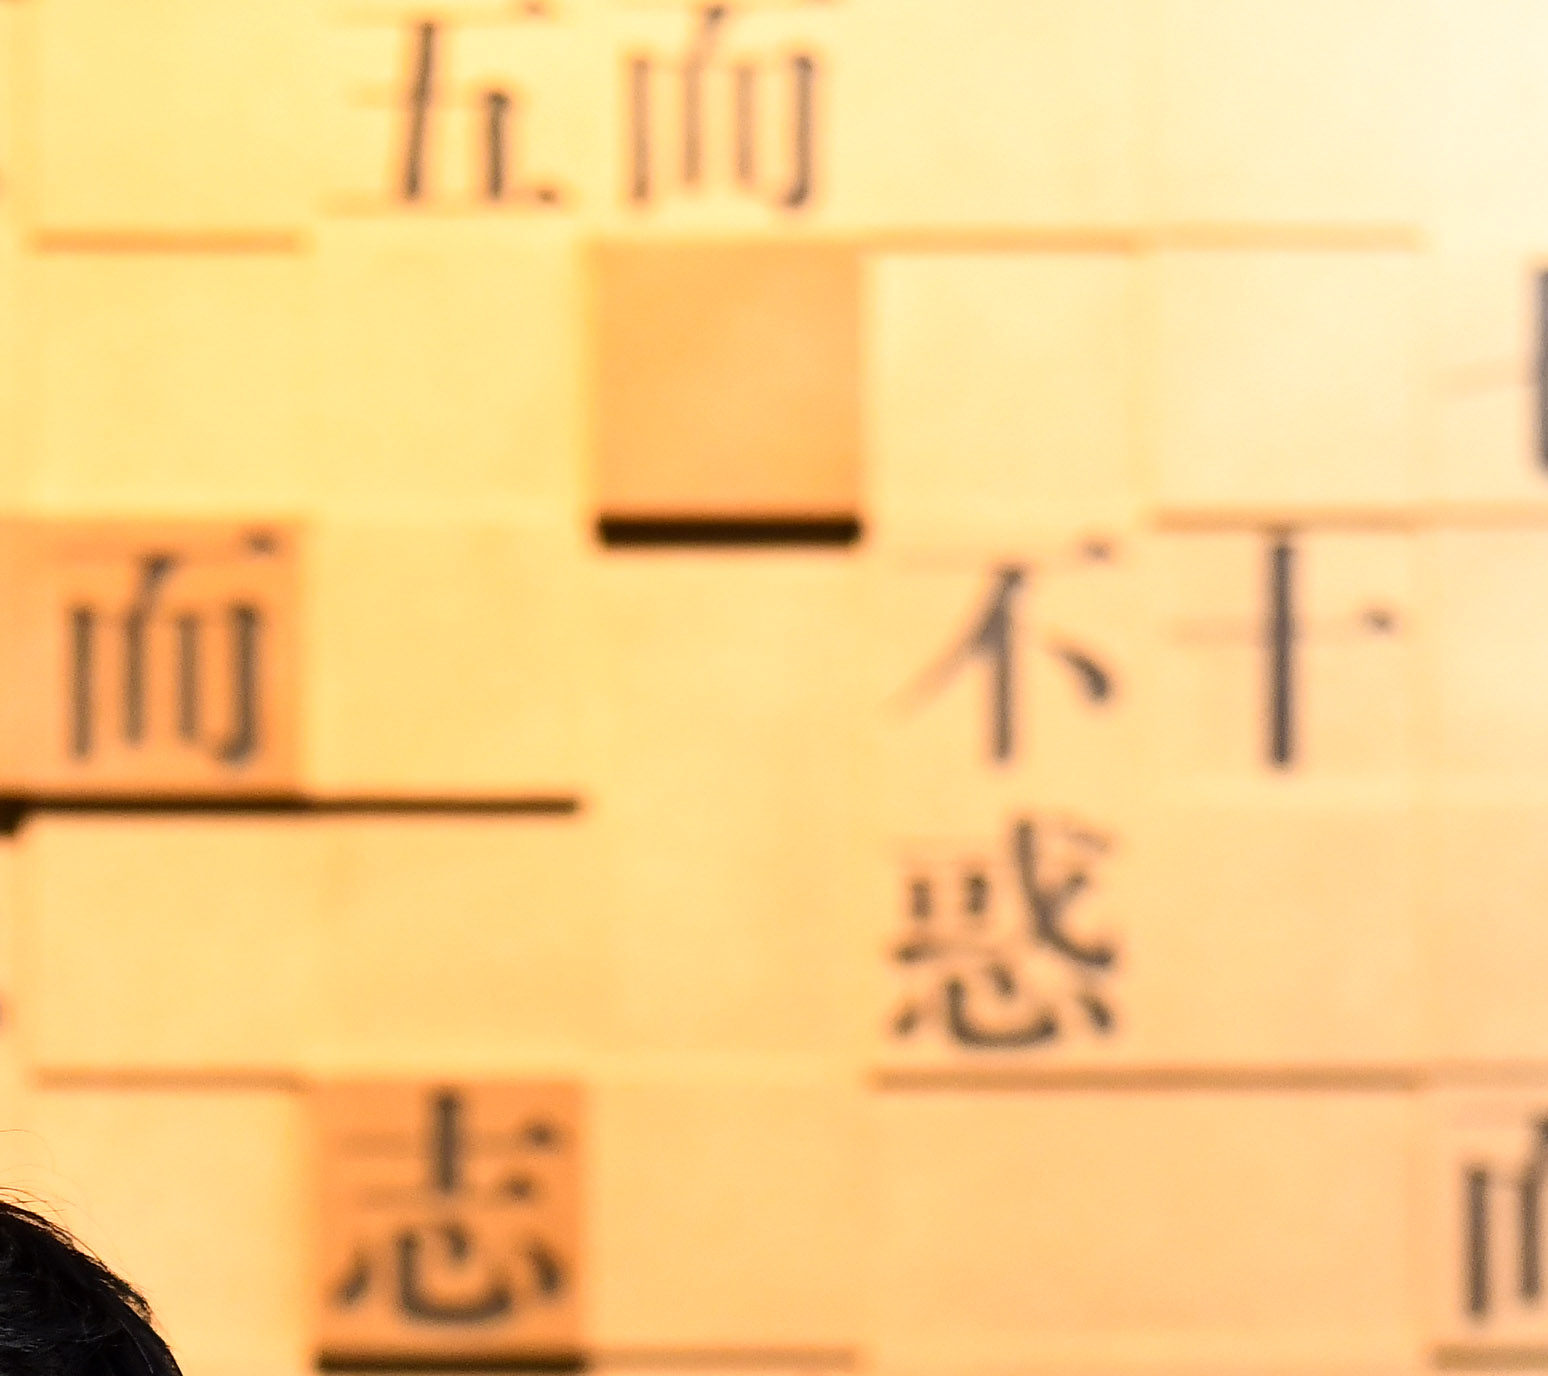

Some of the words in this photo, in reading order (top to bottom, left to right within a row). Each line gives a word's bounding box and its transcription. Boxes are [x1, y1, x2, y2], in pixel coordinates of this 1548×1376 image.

[329, 0, 566, 208] 五
[624, 0, 836, 208] 而
[54, 525, 284, 767] 而
[889, 535, 1119, 767] 不
[1162, 525, 1403, 772] 十
[889, 815, 1121, 1052] 惑
[333, 1086, 567, 1325] 志
